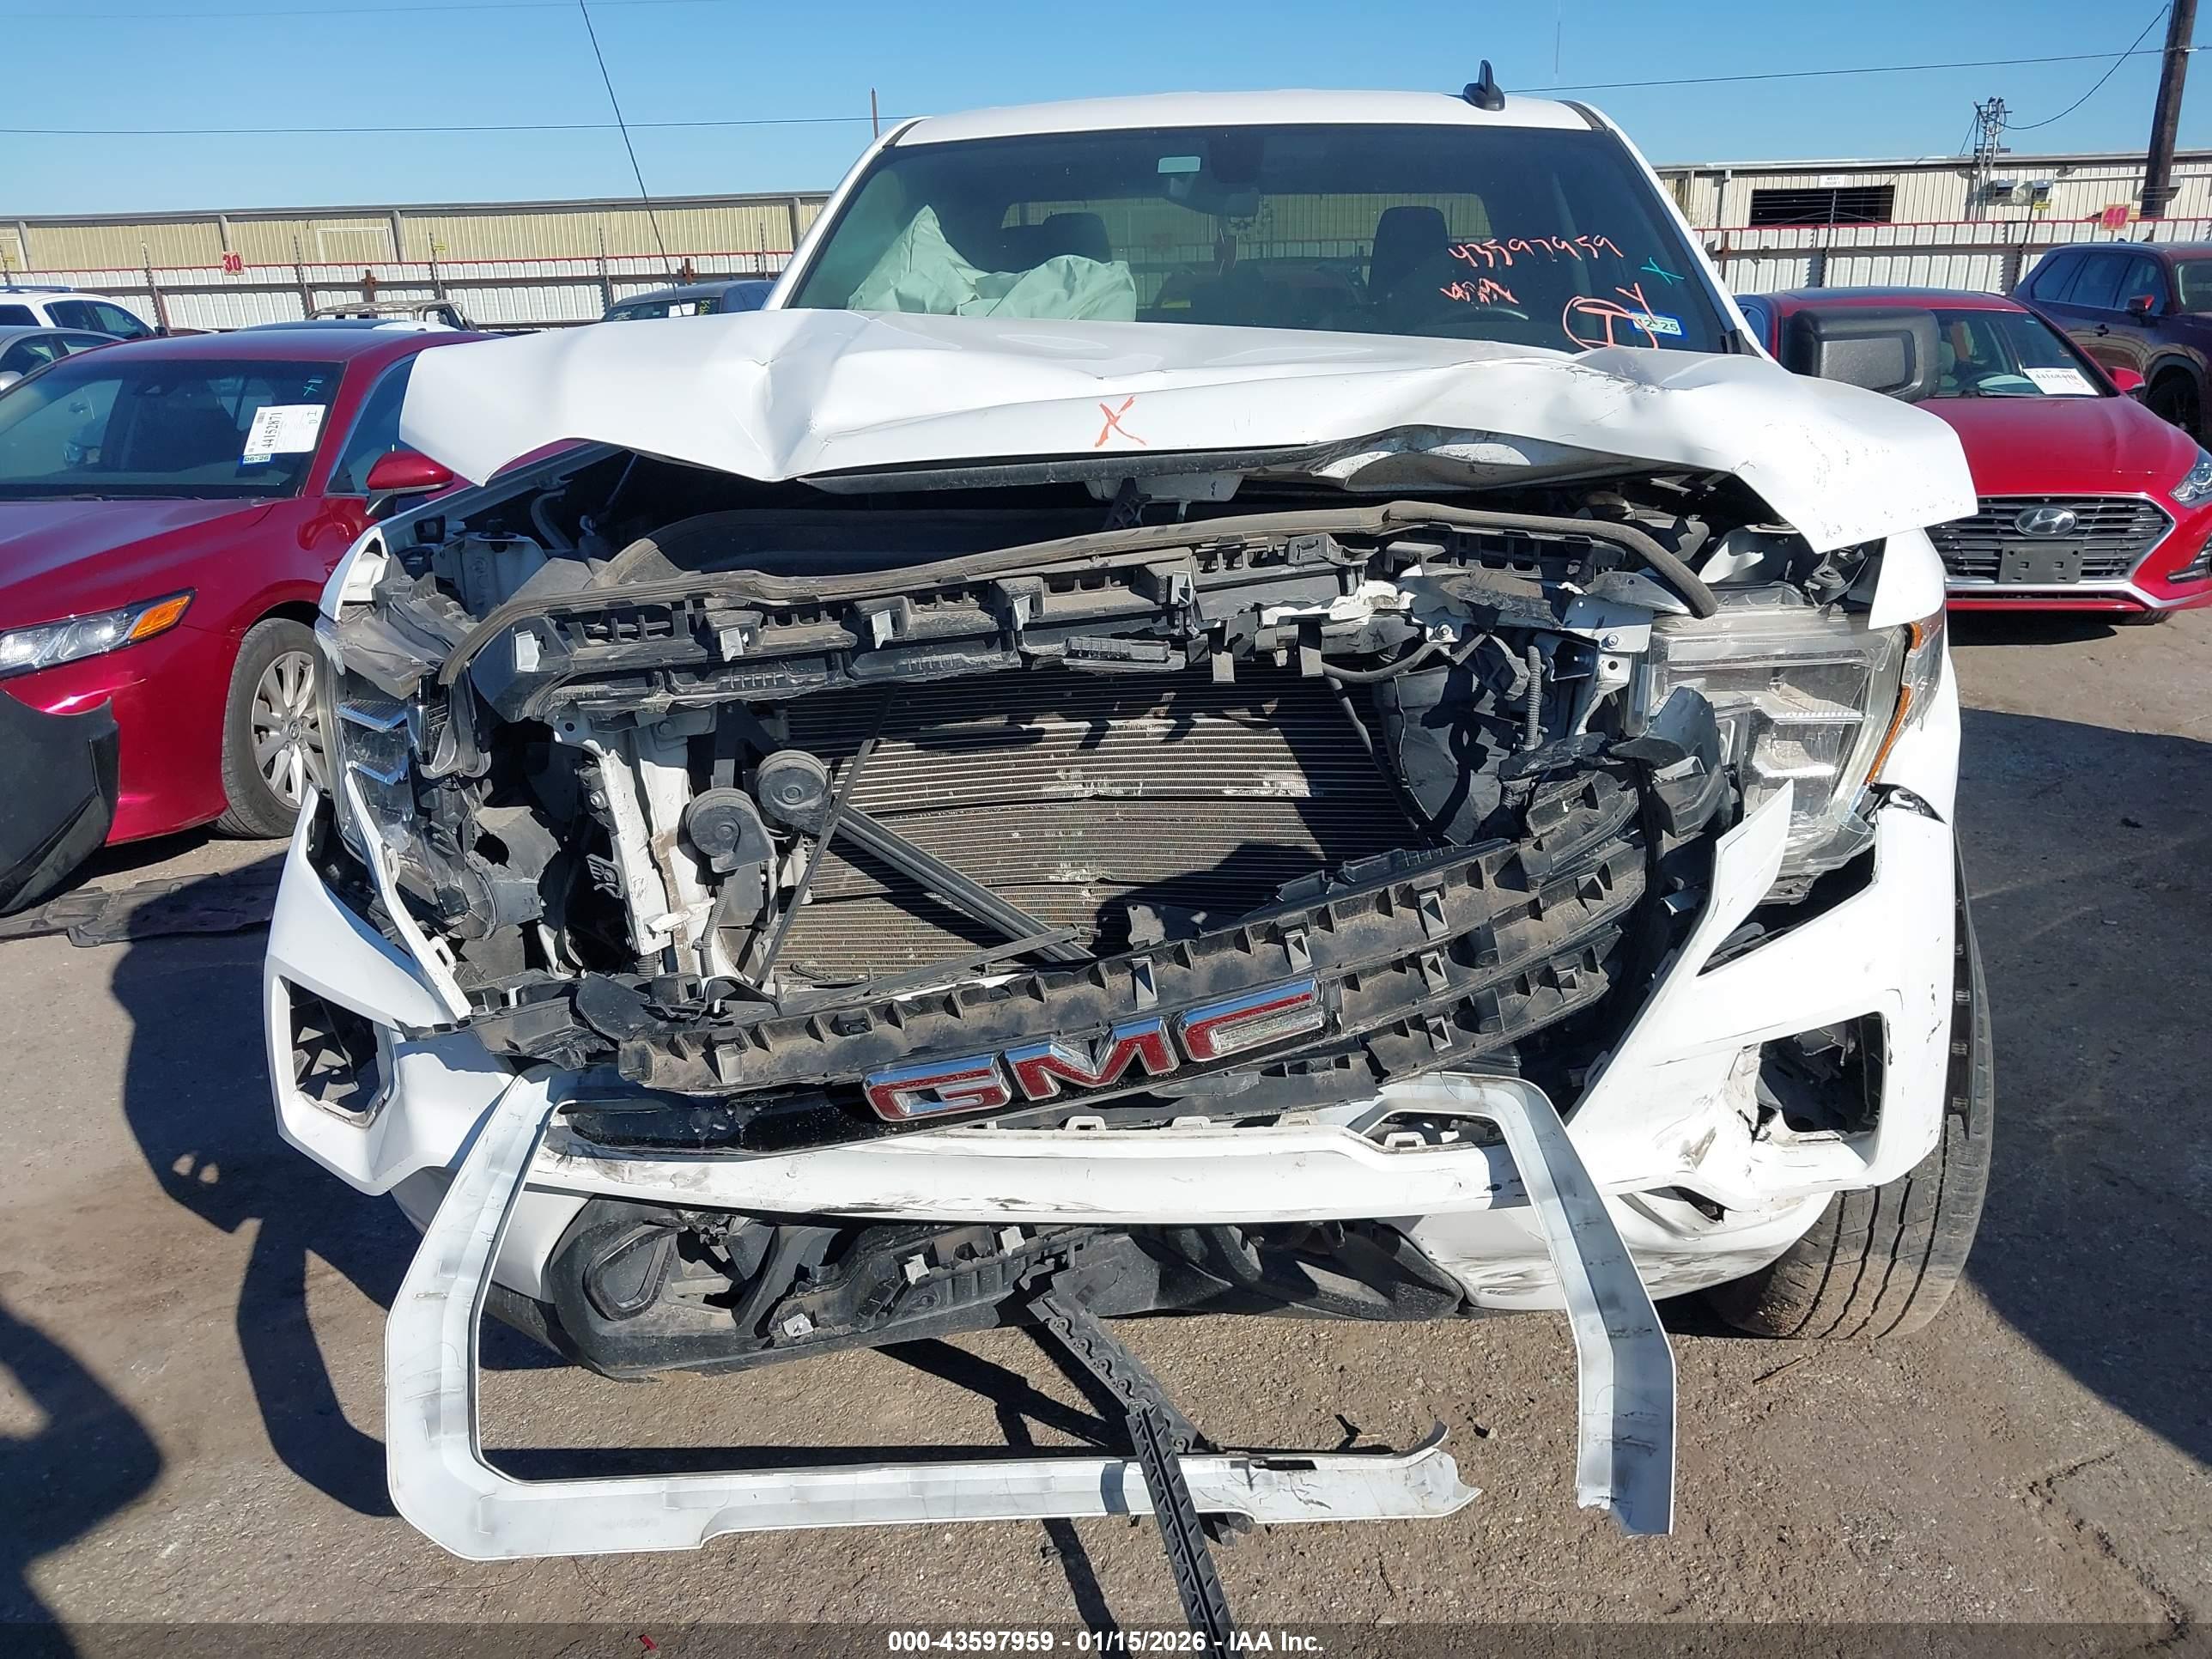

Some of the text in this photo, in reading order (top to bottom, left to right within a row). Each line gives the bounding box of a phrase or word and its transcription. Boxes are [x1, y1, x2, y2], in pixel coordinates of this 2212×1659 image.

[2104, 207, 2129, 228] 40
[222, 253, 241, 274] 30
[1448, 234, 1624, 268] 43597959
[260, 412, 283, 448] 44152871
[863, 978, 1325, 1122] GMC
